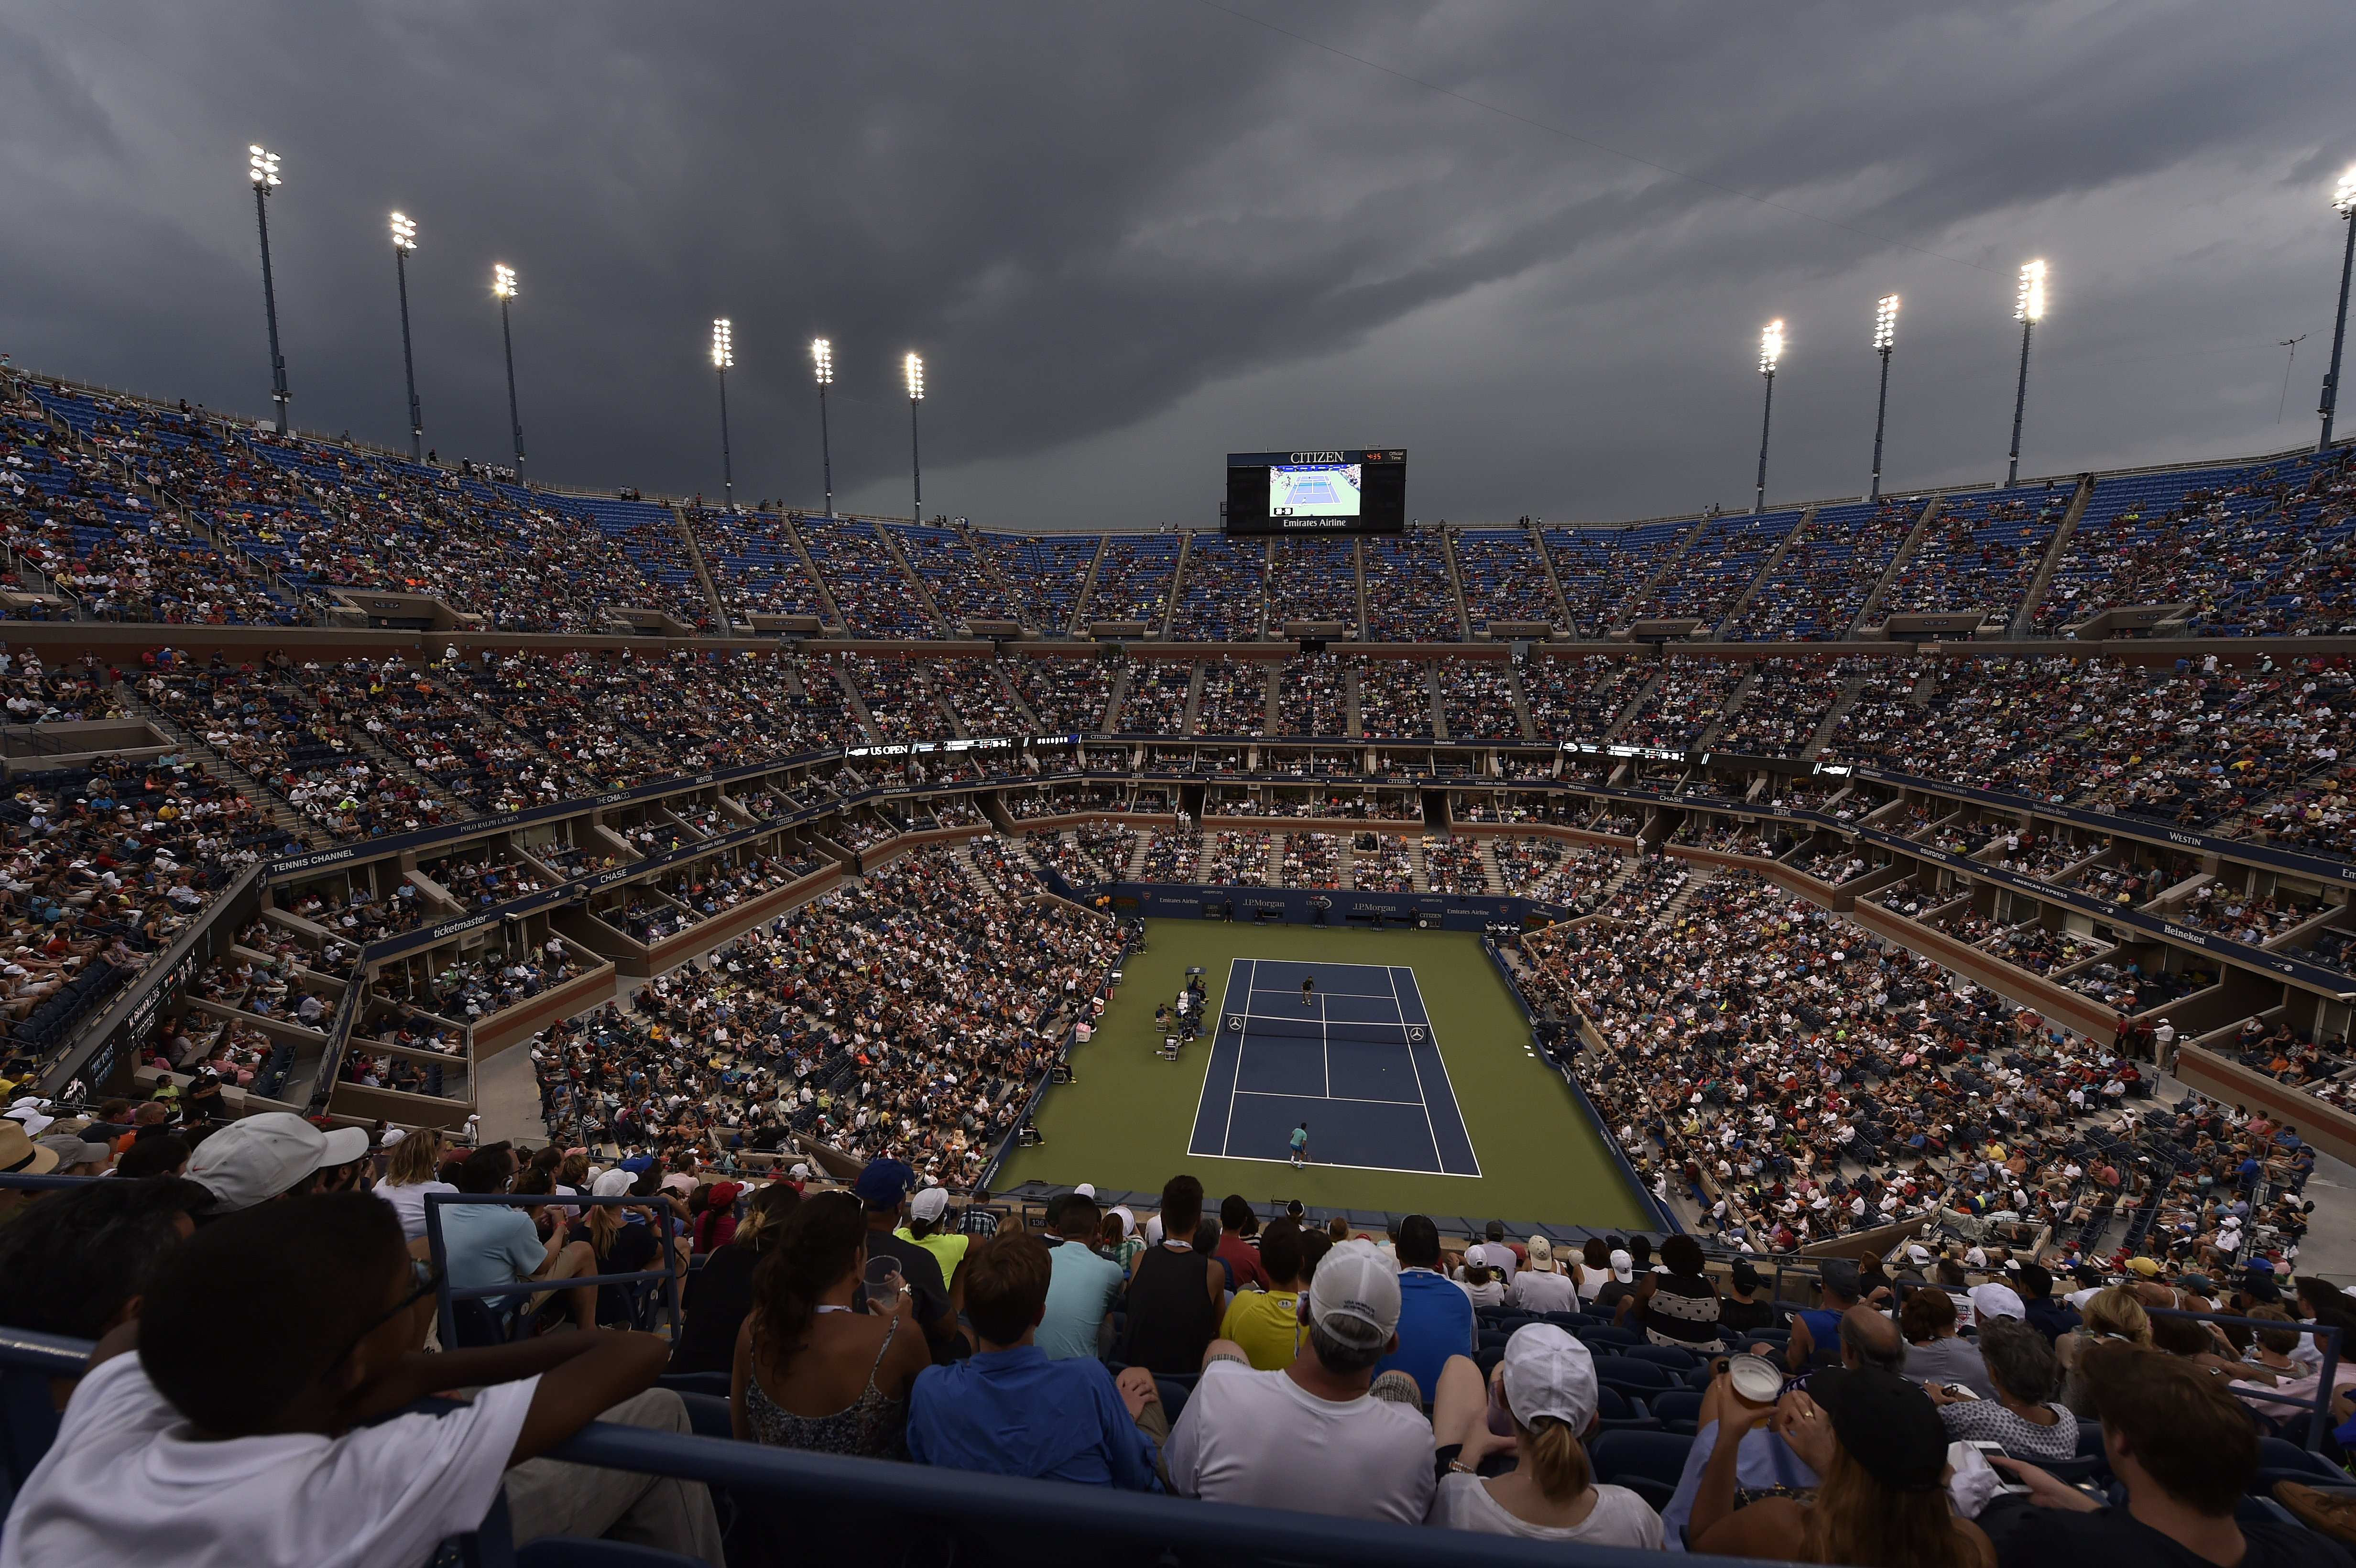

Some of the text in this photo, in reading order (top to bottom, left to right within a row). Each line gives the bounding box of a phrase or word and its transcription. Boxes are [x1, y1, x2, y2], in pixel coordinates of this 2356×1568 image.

[1290, 451, 1345, 464] CITIZEN
[1283, 518, 1346, 527] Emirates Airline
[870, 746, 883, 755] US
[883, 745, 908, 755] OPEN
[695, 774, 713, 784] xerox
[596, 797, 607, 805] THE
[606, 794, 621, 803] CHIA
[1773, 808, 1791, 817] IBM
[2032, 803, 2069, 817] Mercedes-Benz
[460, 815, 519, 833] POLO RALPH LAUREN
[776, 816, 794, 827] CITIZEN
[1837, 821, 1849, 830] Mount
[697, 838, 726, 852] Emirates Airline
[2169, 831, 2202, 846] WESTIN
[1920, 847, 1946, 860] esurance
[272, 849, 355, 872] TENNIS CHANNEL
[600, 868, 627, 883] CHASE
[2012, 877, 2041, 891] AMERICAN
[1532, 908, 1553, 916] Heineken
[433, 914, 488, 938] ticketmaster
[2164, 924, 2205, 945] Heineken
